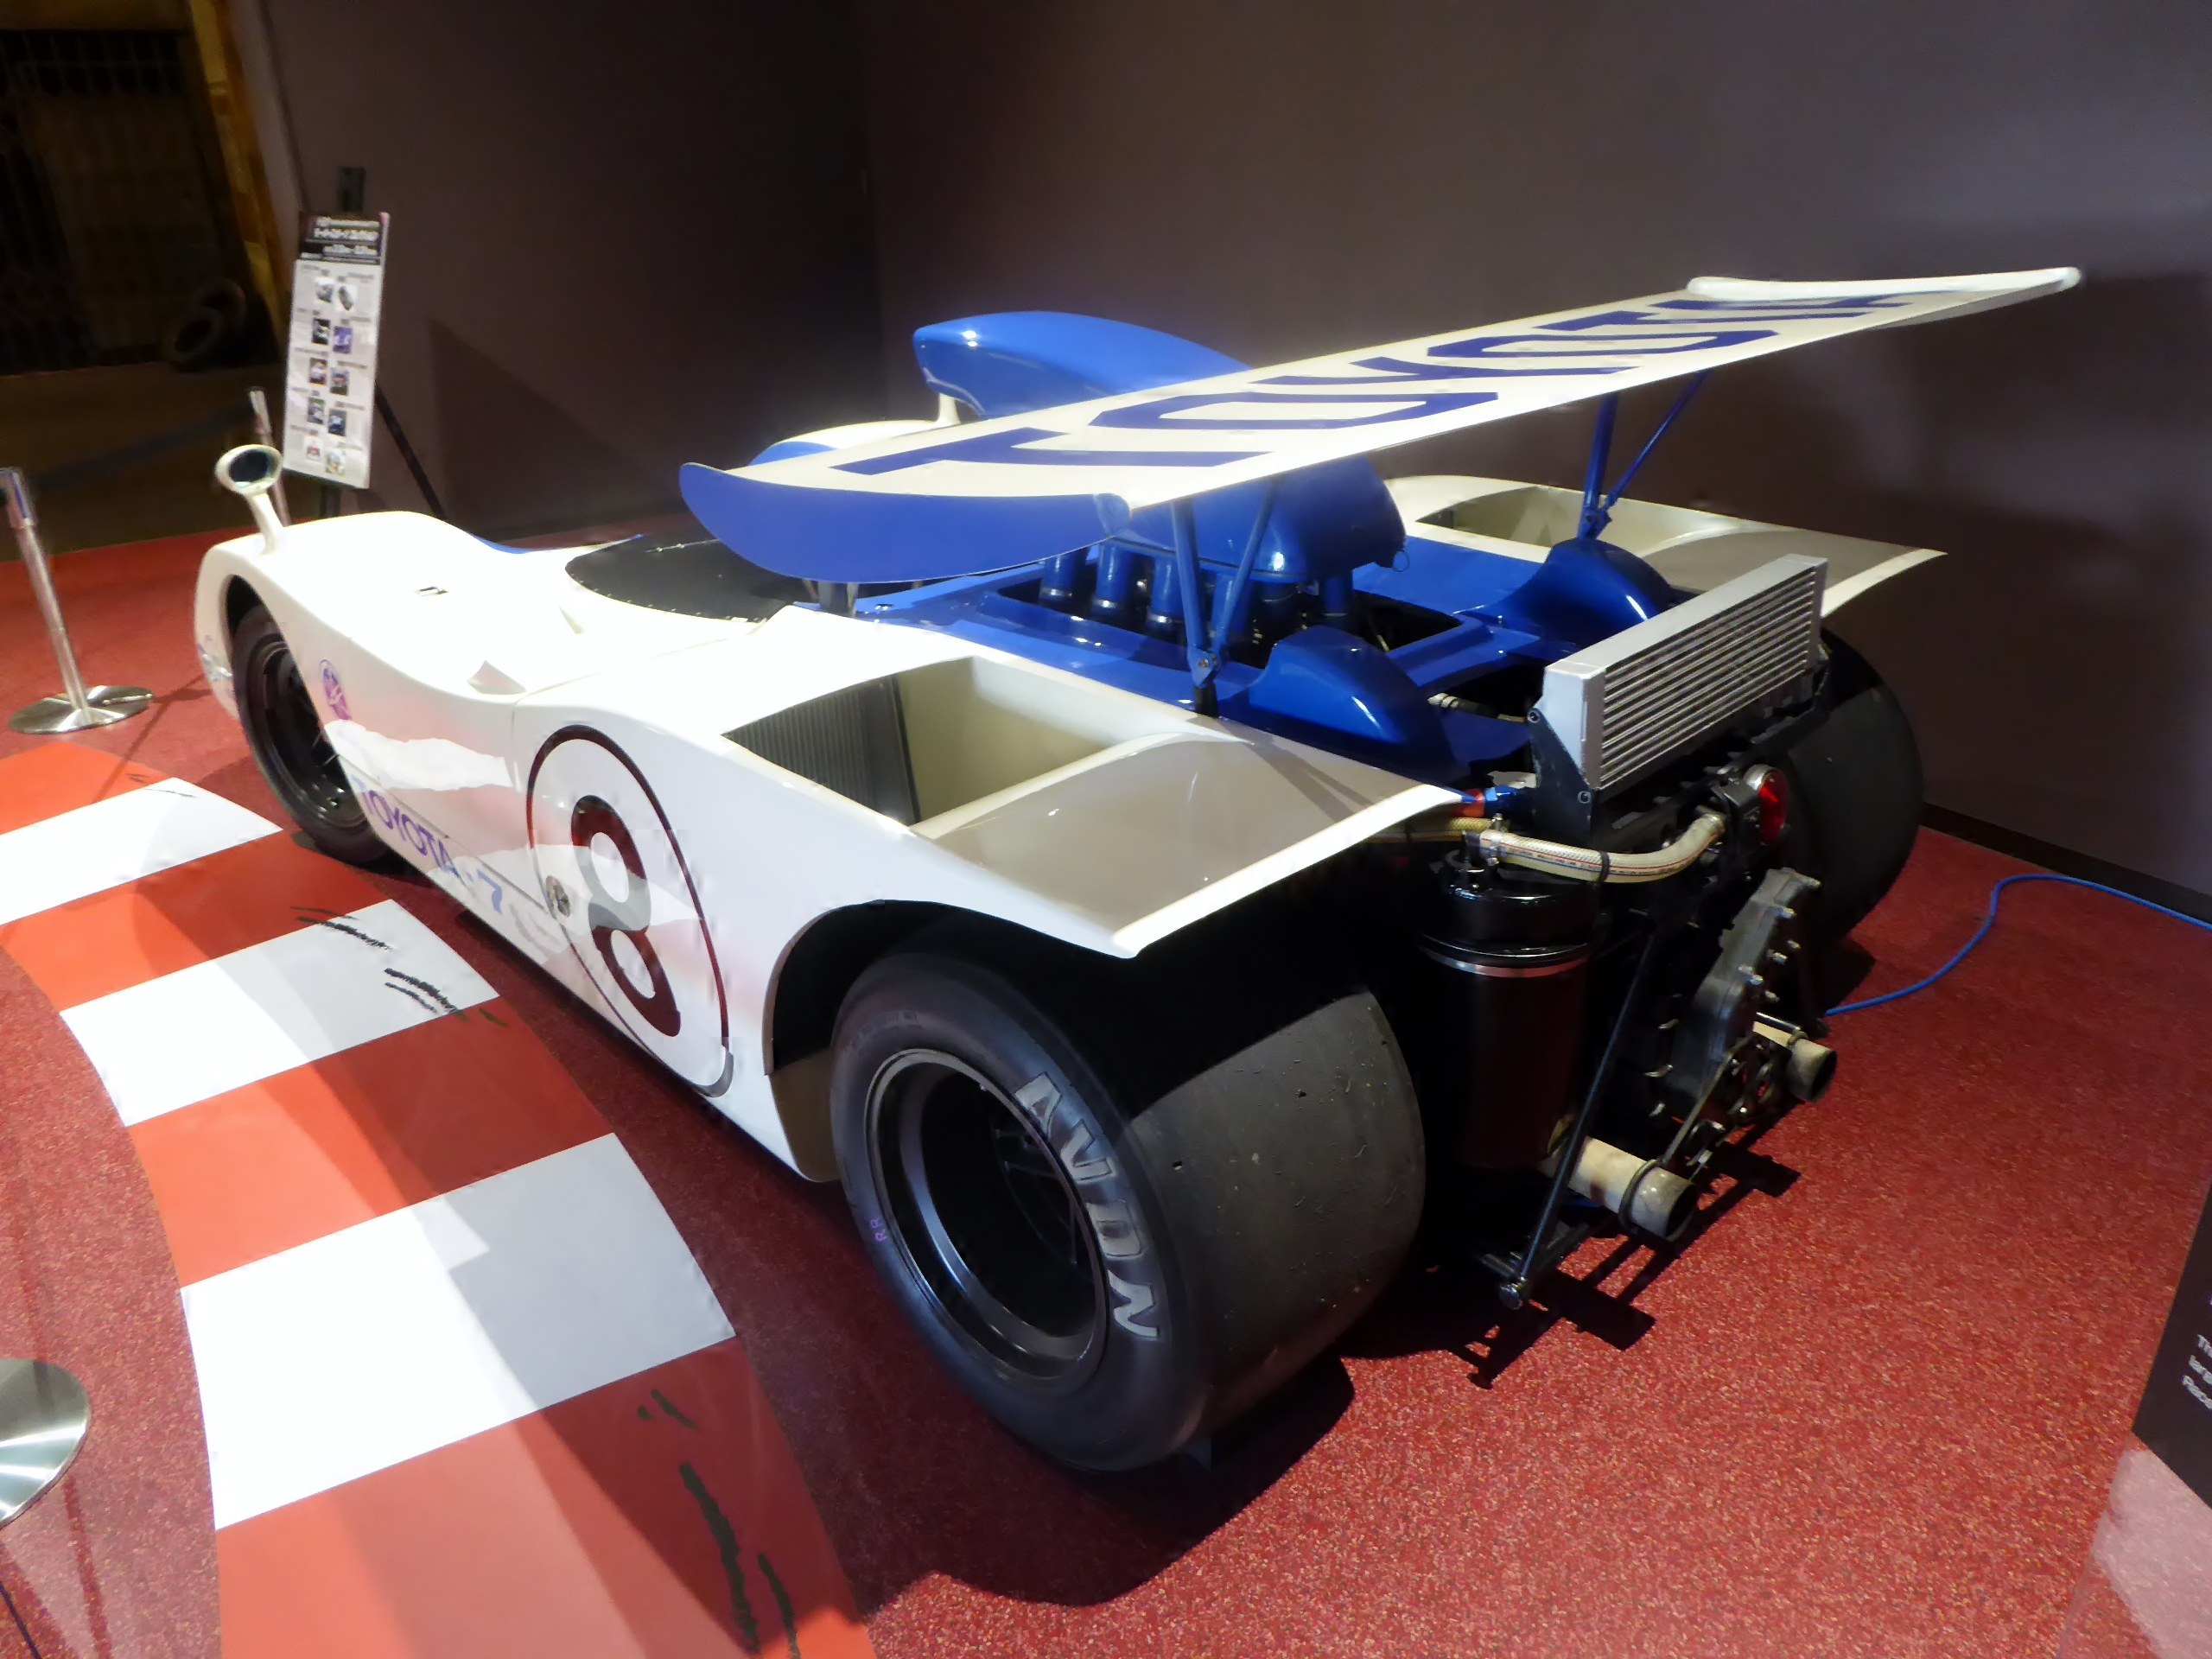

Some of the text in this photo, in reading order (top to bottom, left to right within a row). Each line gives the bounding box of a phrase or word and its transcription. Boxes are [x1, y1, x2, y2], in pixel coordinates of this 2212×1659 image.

[828, 289, 1970, 476] TOYOTA
[571, 794, 682, 1037] 8
[1014, 1071, 1160, 1341] AVON
